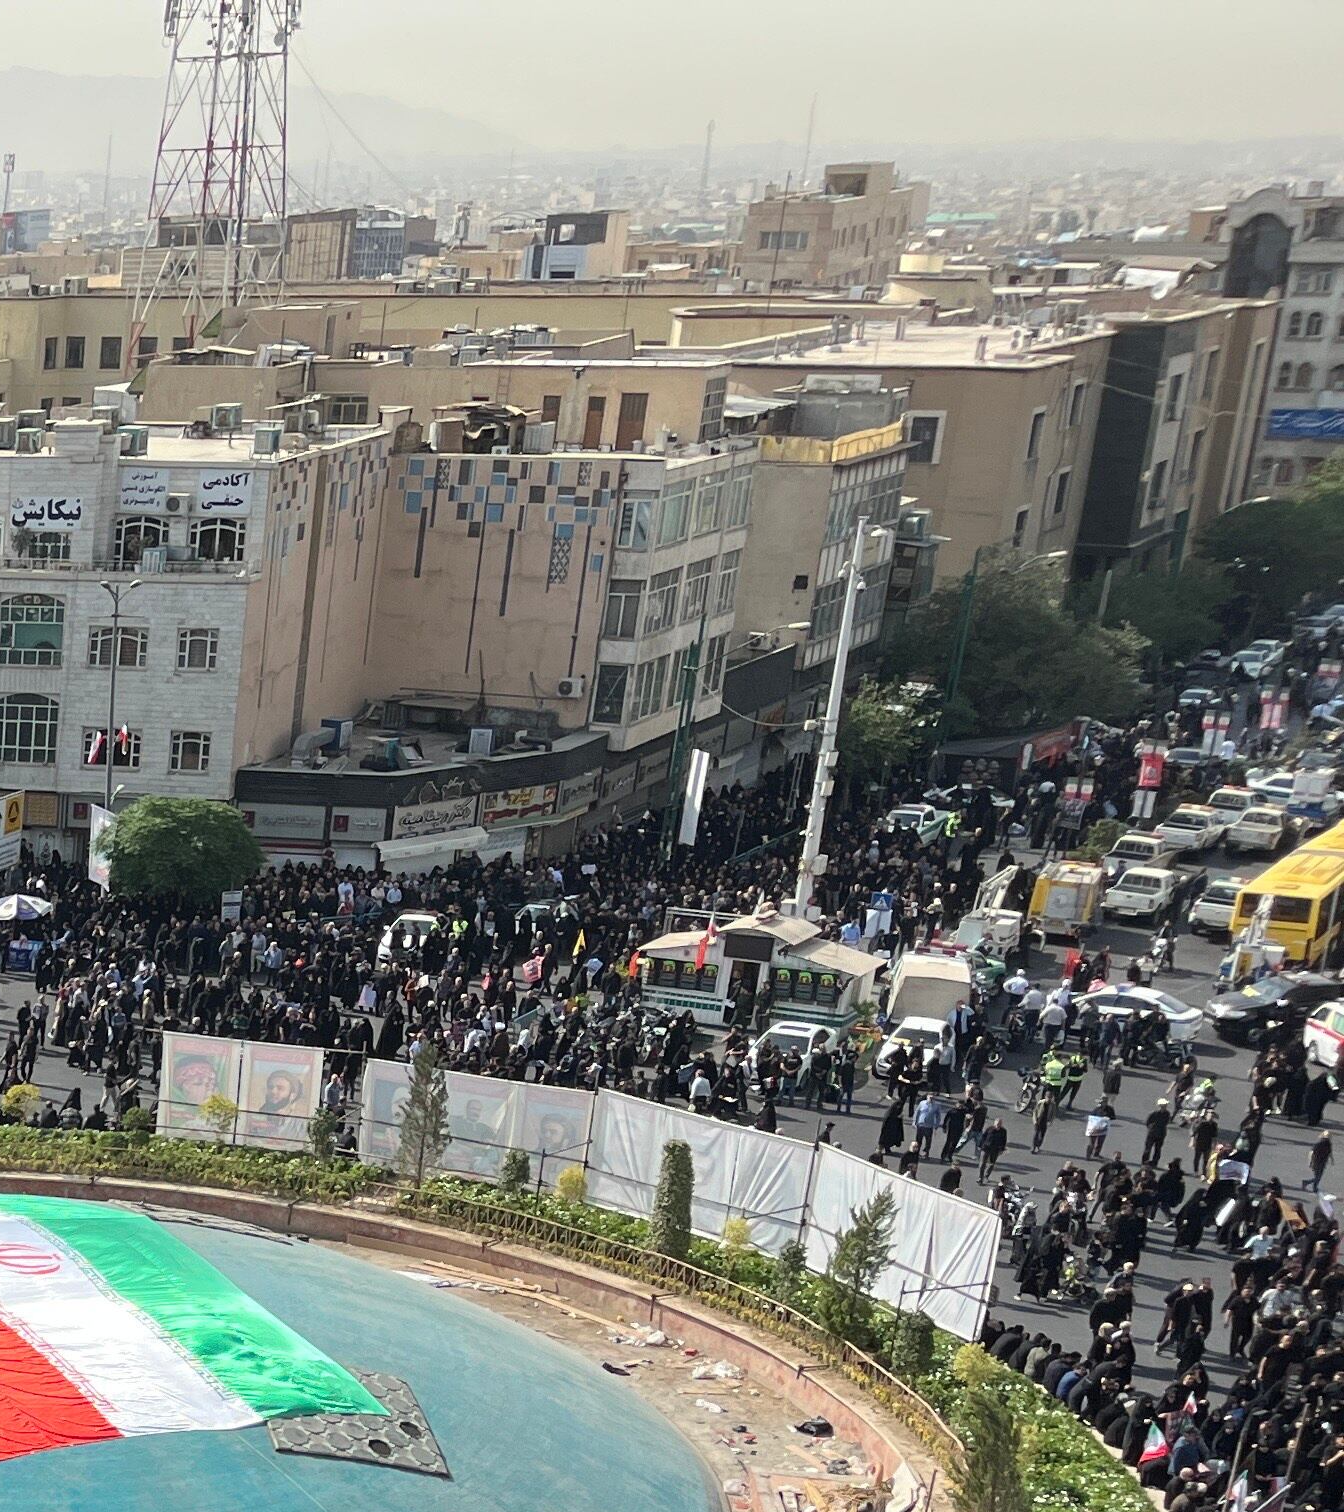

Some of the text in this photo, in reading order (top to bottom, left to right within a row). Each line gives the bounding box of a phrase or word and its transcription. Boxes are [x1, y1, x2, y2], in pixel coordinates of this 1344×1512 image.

[202, 472, 250, 490] آکادمی
[201, 493, 244, 510] حنفی
[12, 498, 81, 528] نیکایش
